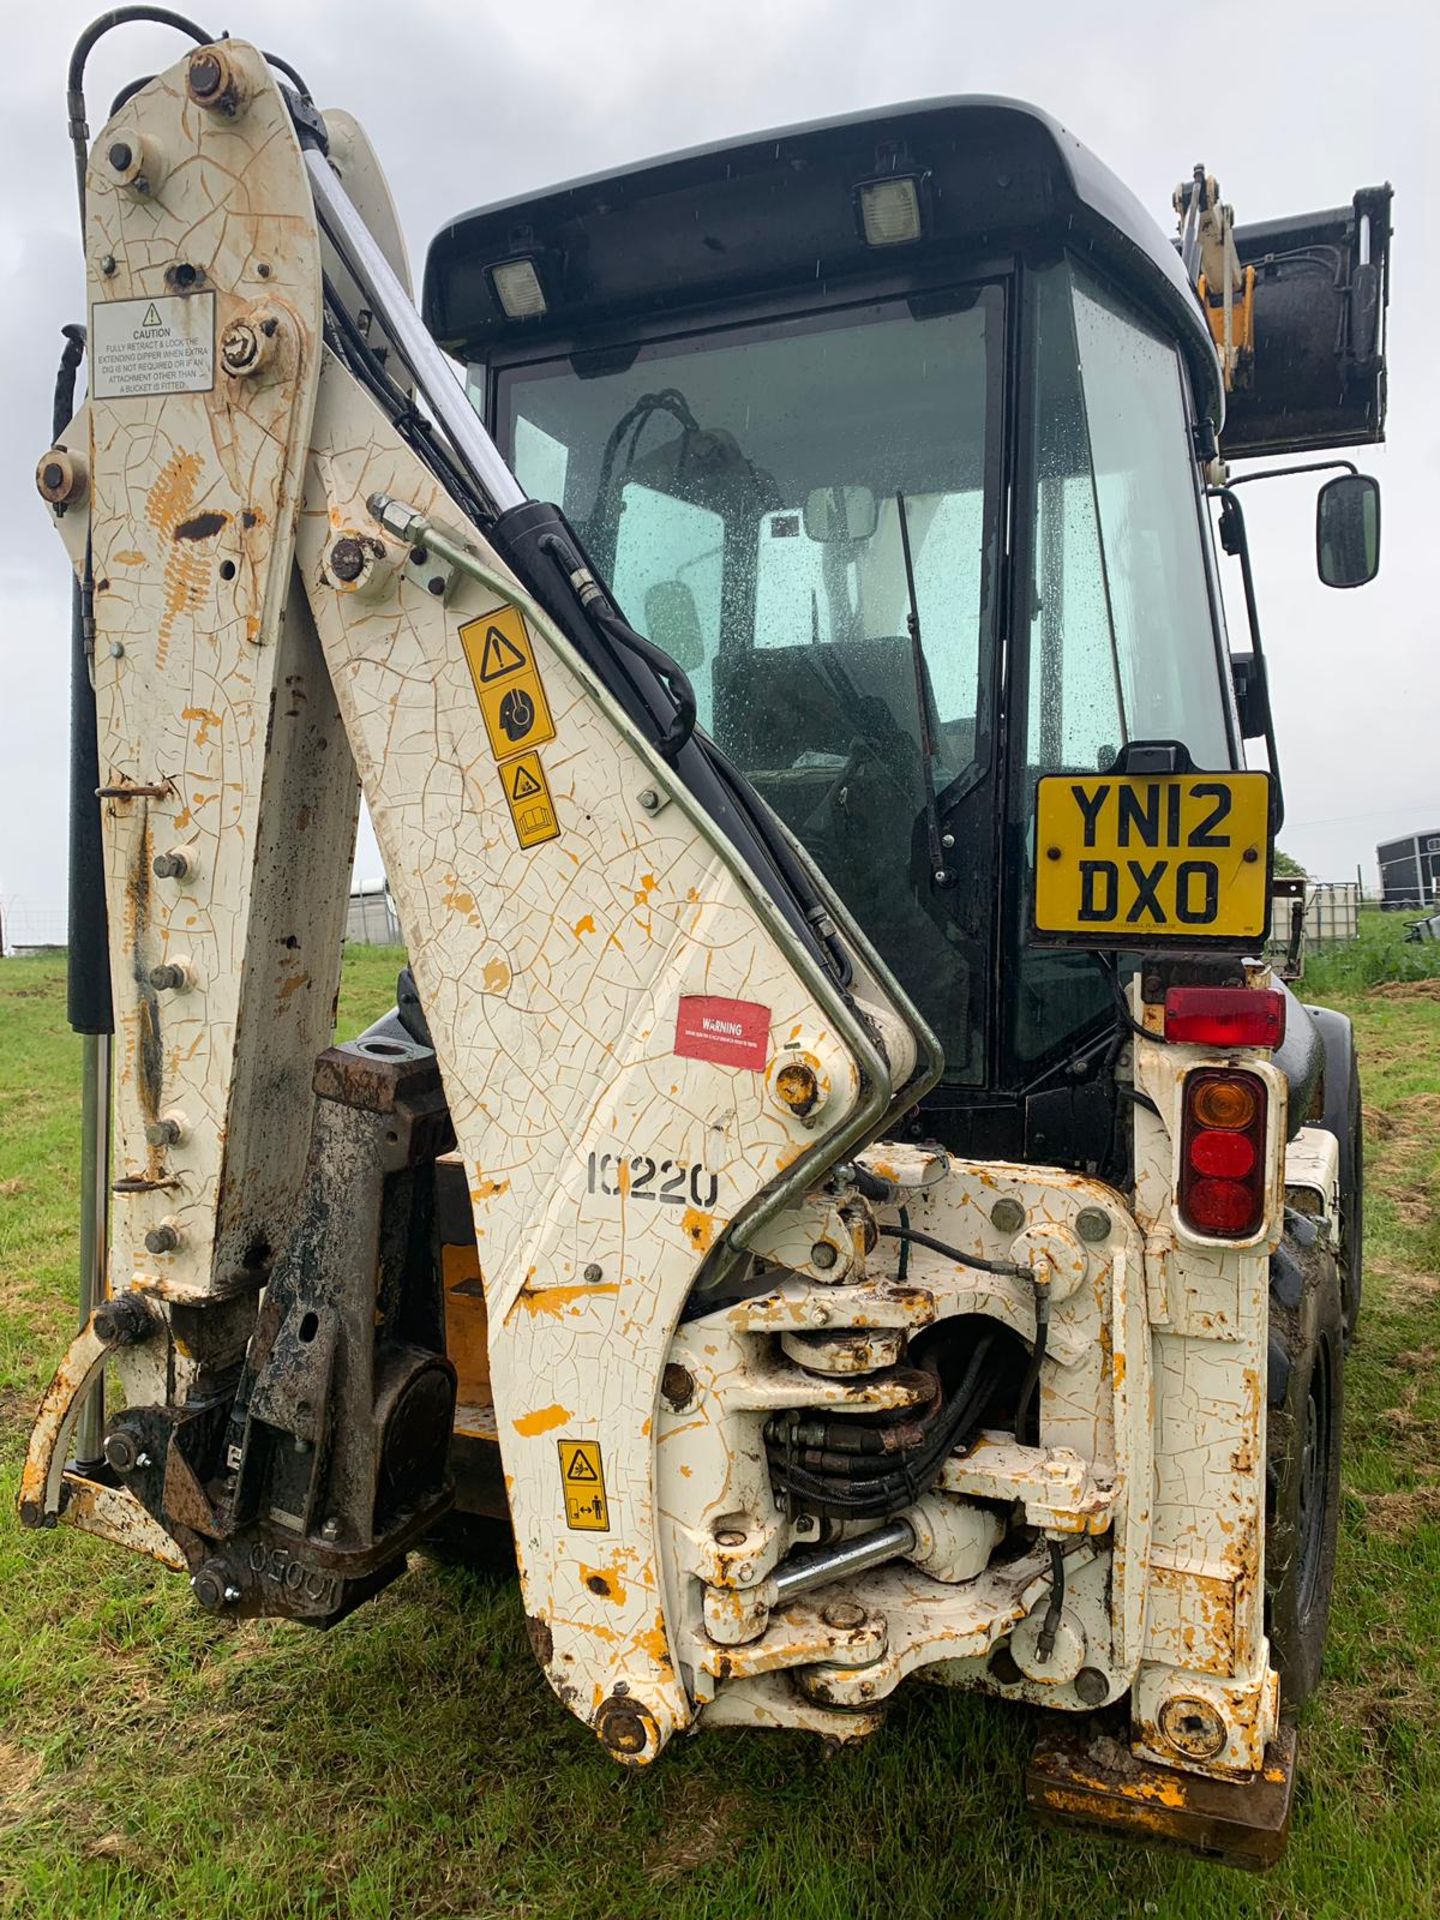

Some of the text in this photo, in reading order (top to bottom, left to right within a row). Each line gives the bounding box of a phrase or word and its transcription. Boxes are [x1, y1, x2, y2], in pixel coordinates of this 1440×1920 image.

[133, 328, 170, 340] CAUTION
[106, 343, 126, 353] FULLY
[126, 341, 159, 351] RETRACT
[165, 339, 184, 348] LOCK
[185, 337, 199, 346] THE
[98, 347, 208, 364] EXTENDING DIPPER WHEN EXTRA
[122, 364, 137, 372] NOT
[137, 361, 173, 371] REQUIRED
[108, 370, 197, 384] ATTACHMENT OTHER THAN
[125, 384, 152, 393] BUCKET
[1071, 783, 1232, 848] YN12
[1077, 860, 1219, 924] DXO
[702, 1017, 743, 1036] WARNING
